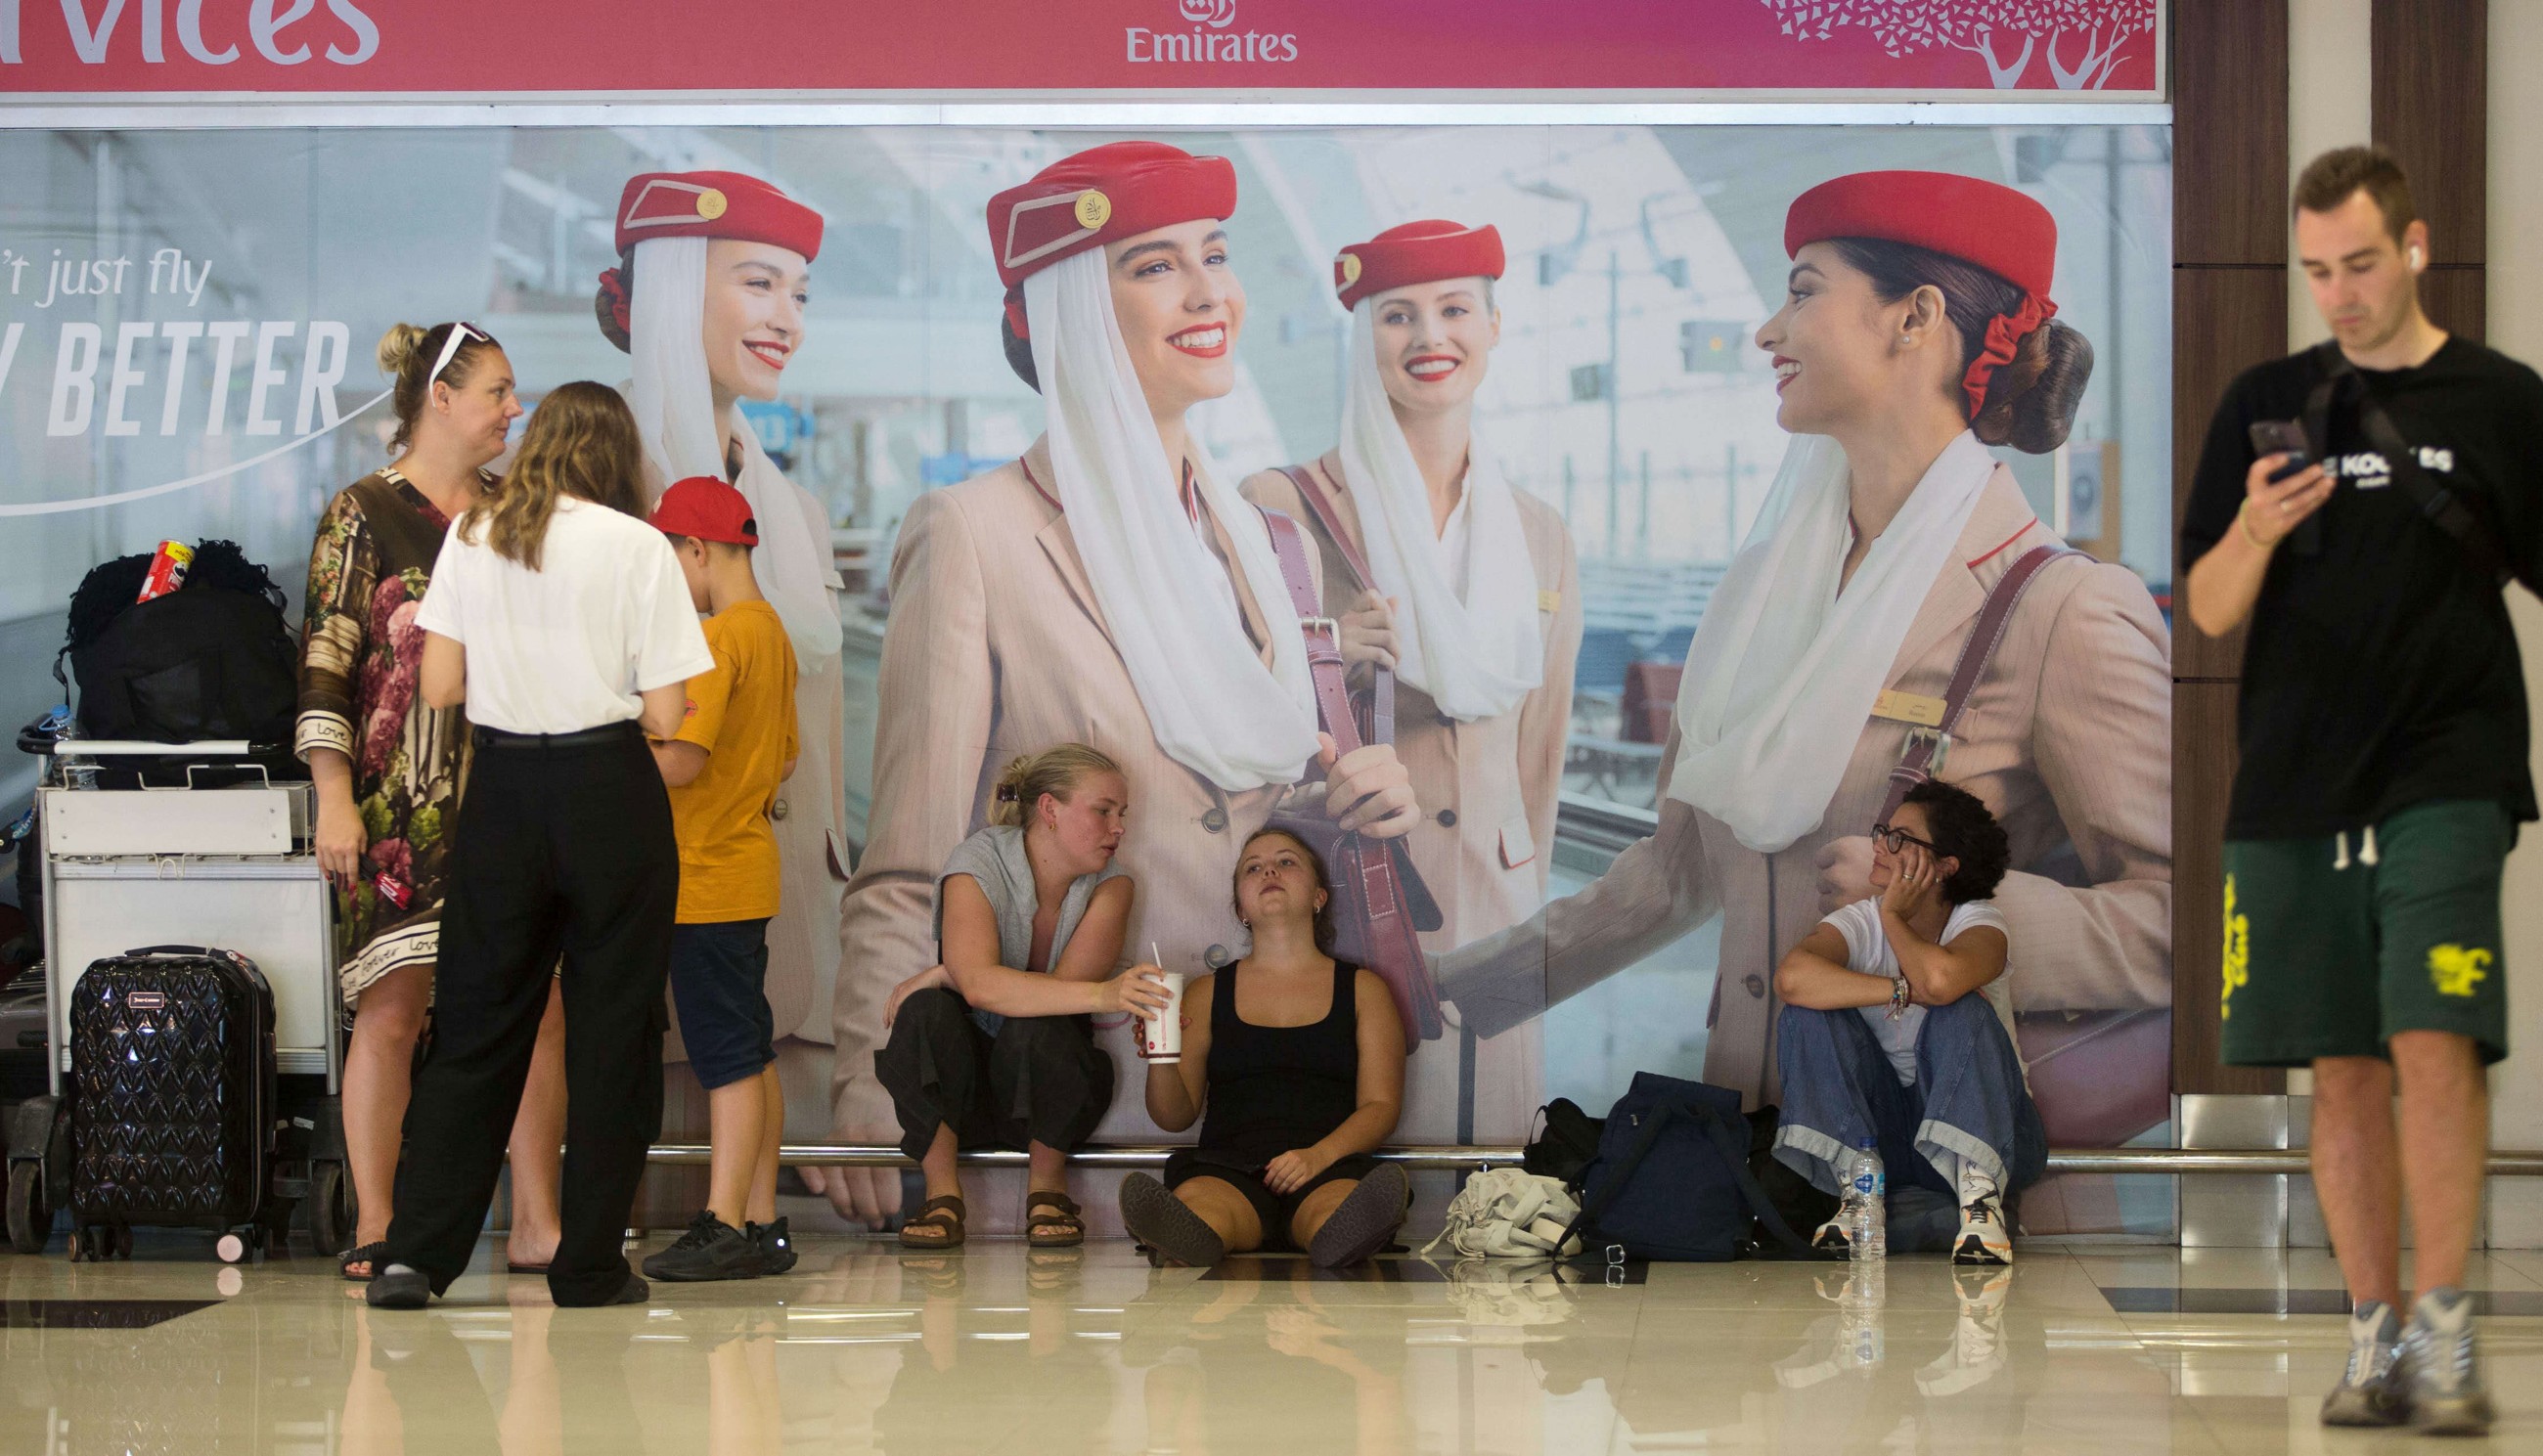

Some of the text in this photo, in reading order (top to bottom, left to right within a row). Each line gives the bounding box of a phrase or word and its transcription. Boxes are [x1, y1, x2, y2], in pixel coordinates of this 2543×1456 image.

[1125, 25, 1298, 63] Emirates
[34, 248, 132, 309] just
[150, 248, 213, 307] fly
[46, 321, 350, 437] BETTER
